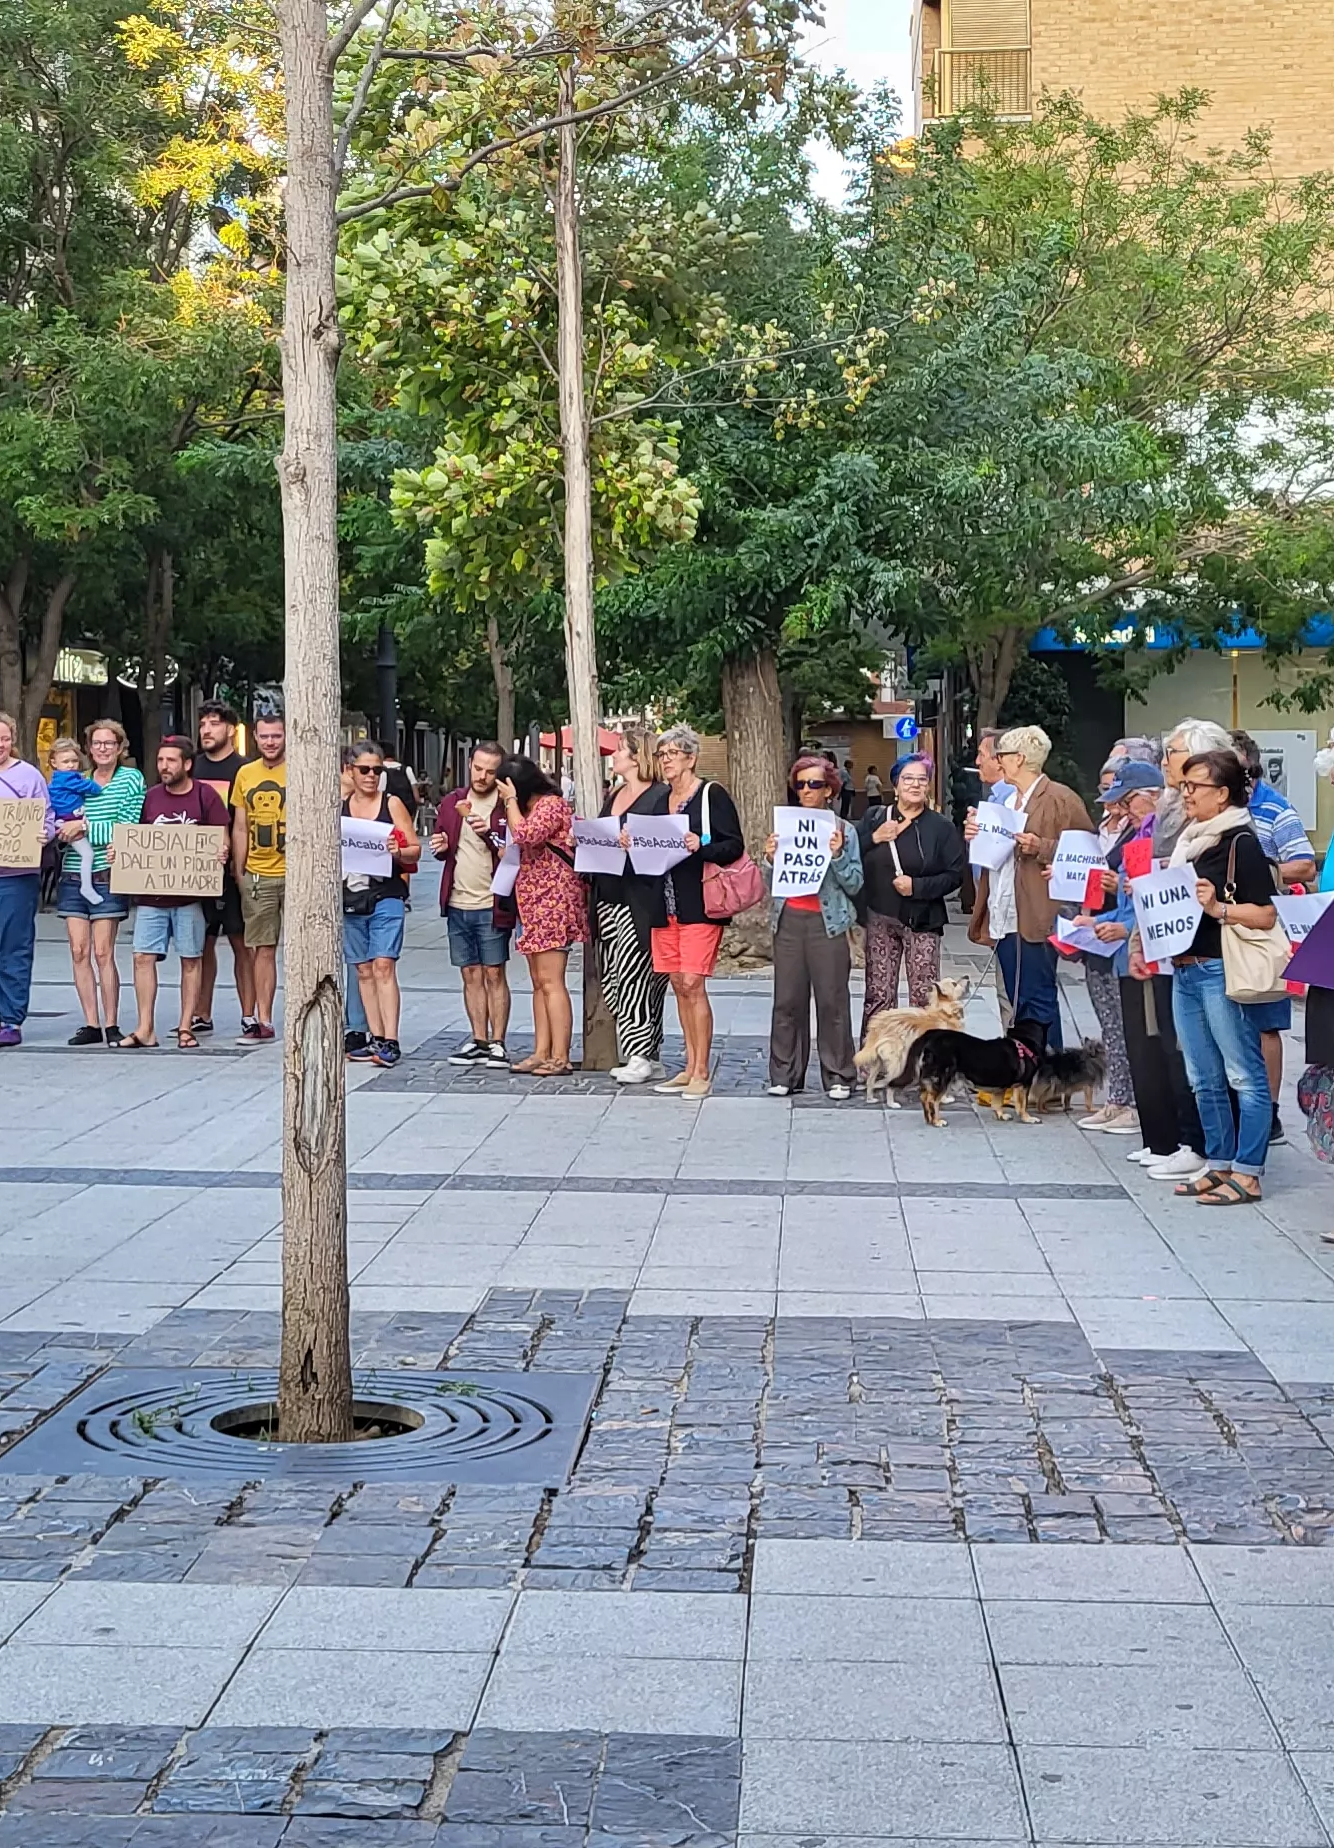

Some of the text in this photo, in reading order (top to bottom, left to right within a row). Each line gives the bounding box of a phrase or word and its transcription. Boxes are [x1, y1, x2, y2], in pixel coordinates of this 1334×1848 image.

[798, 819, 815, 832] NI
[341, 837, 385, 851] eAcabó
[794, 836, 818, 850] UN
[120, 852, 155, 870] DALE
[160, 855, 177, 870] UN
[783, 852, 825, 867] PASO
[1056, 853, 1064, 863] EL
[145, 873, 219, 892] A TU MADRE
[778, 868, 823, 884] ATRÁS
[1066, 871, 1087, 882] MATA
[1140, 884, 1191, 911] NI UNA
[1147, 915, 1194, 941] MENOS
[1289, 923, 1302, 935] EL
